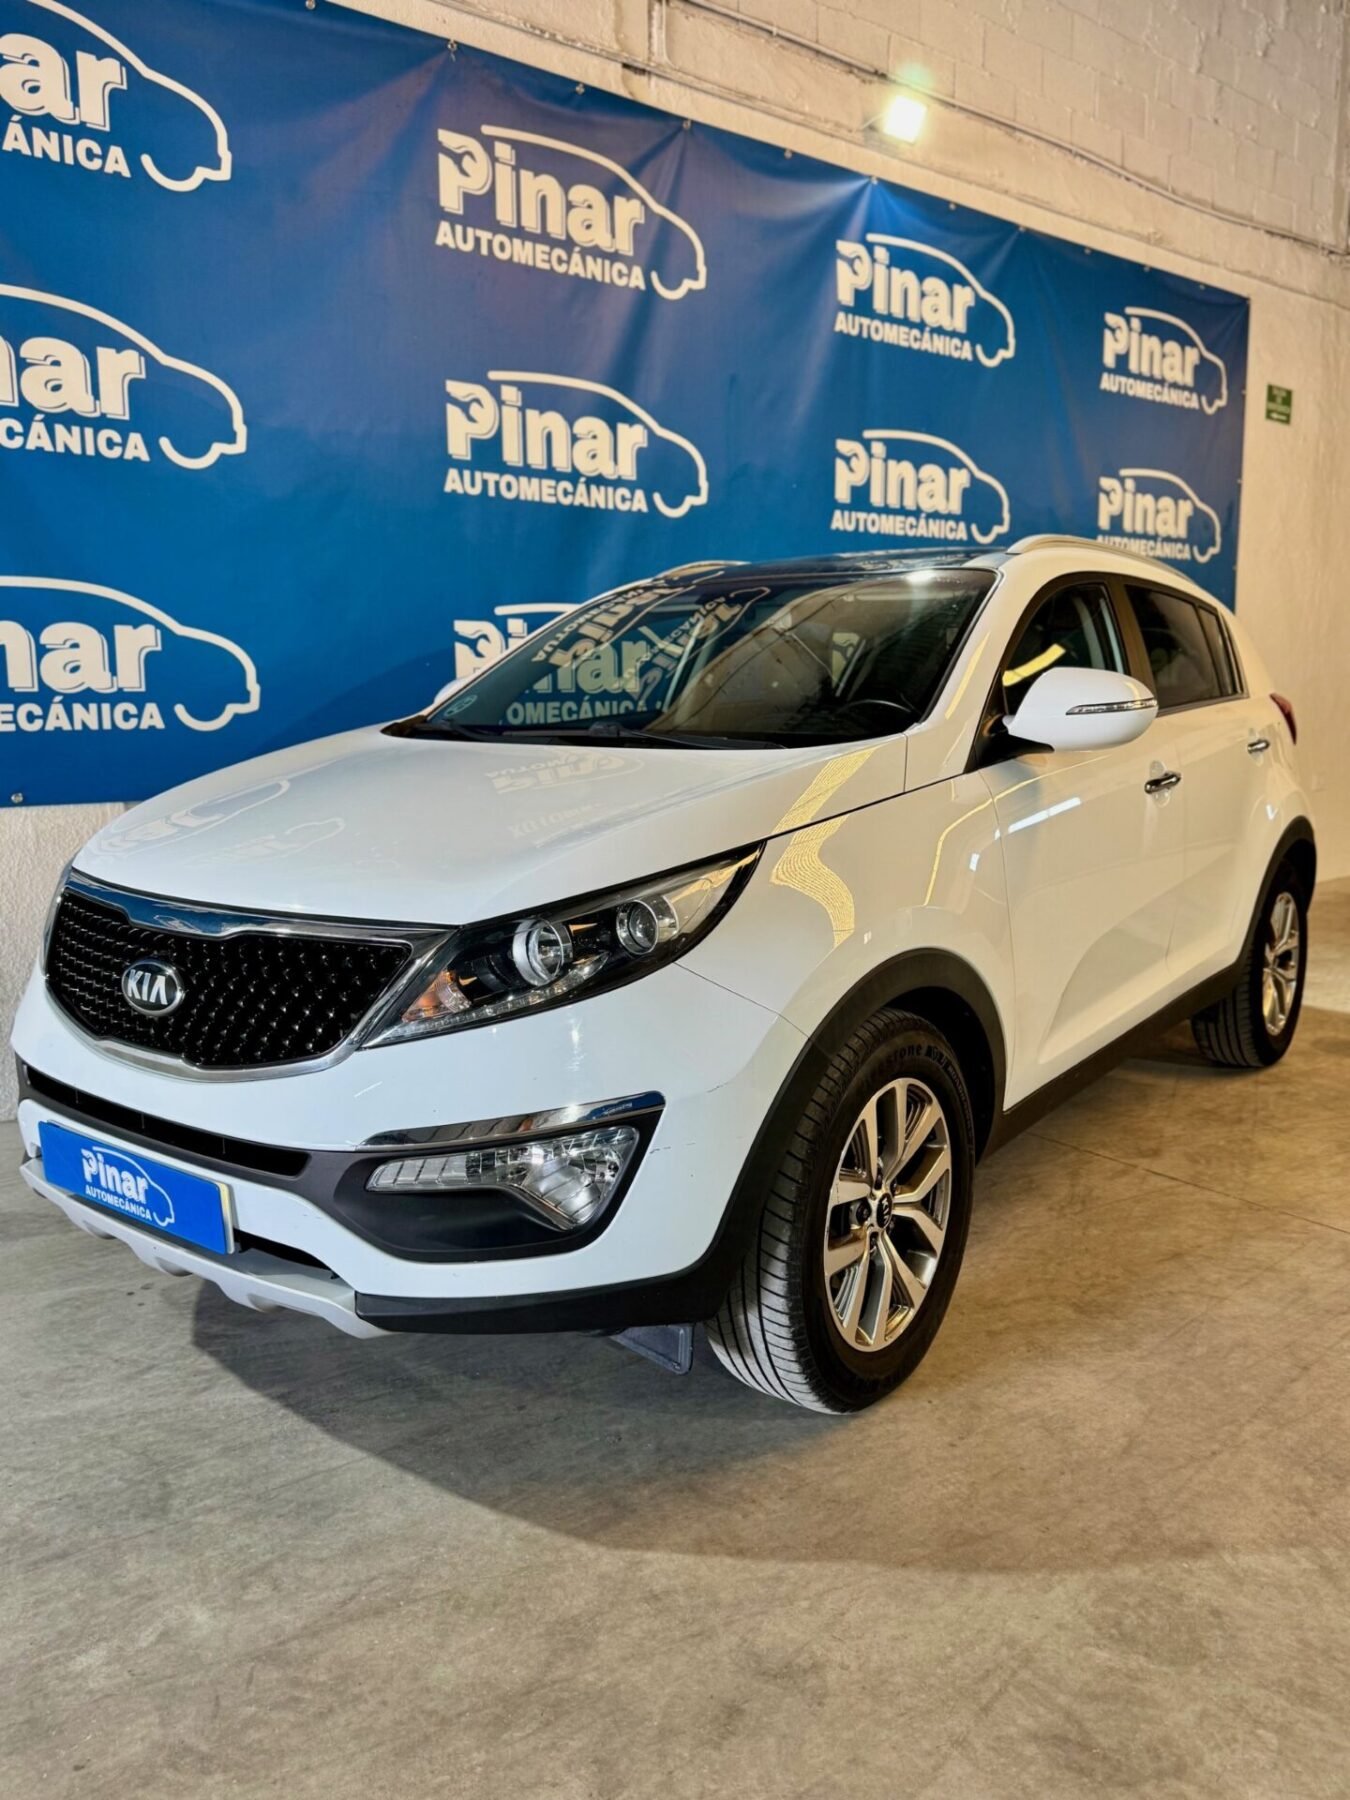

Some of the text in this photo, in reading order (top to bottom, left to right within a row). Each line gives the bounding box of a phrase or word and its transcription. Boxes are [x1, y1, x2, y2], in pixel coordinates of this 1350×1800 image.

[2, 115, 131, 178] ÁNICA
[437, 128, 645, 256] Pinar
[435, 220, 646, 290] AUTOMECÁNICA
[836, 239, 975, 334] Pinar
[834, 311, 973, 361] AUTOMECÁNICA
[1103, 312, 1200, 388] Pinar
[1099, 372, 1199, 410] AUTOMECÁNICA
[0, 413, 150, 462] CÁNICA
[445, 379, 648, 481] Pinar
[443, 467, 648, 513] AUTOMECÁNICA
[834, 438, 971, 515] Pinar
[831, 509, 968, 541] AUTOMECÁNICA
[1098, 476, 1194, 539] Pinar
[127, 968, 169, 1006] KIA
[81, 1148, 149, 1204] Pinar
[85, 1184, 153, 1221] AUTOMECÁNICA
